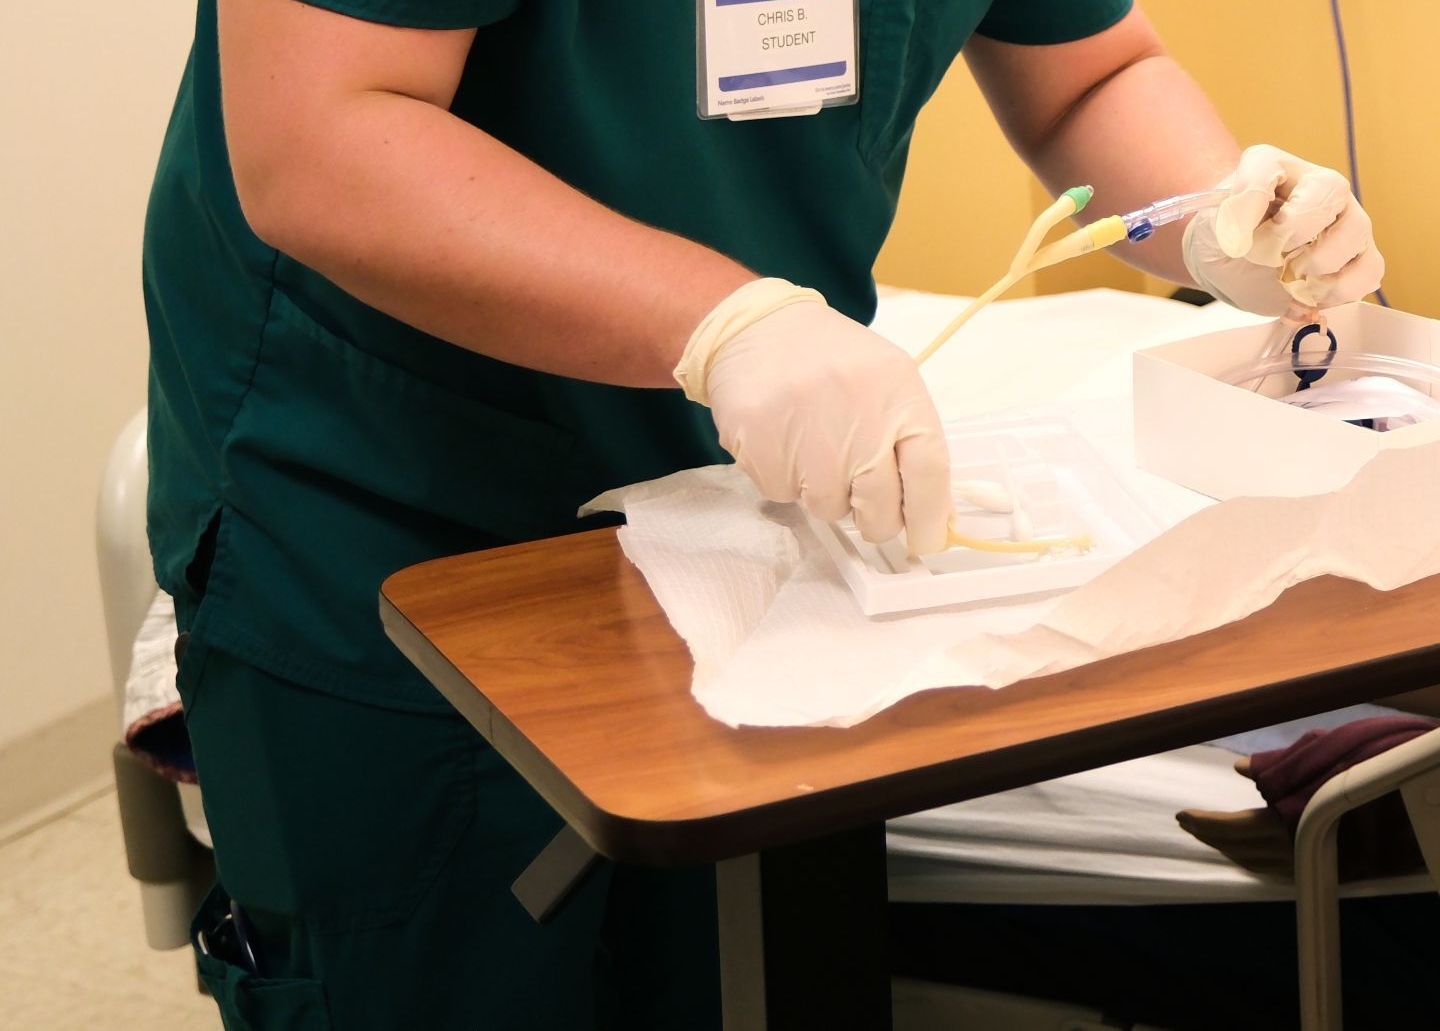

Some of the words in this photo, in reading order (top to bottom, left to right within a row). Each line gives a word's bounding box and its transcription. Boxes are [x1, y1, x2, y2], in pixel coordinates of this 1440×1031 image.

[757, 9, 794, 26] CHRIS
[797, 8, 808, 21] B.
[761, 30, 816, 51] STUDENT
